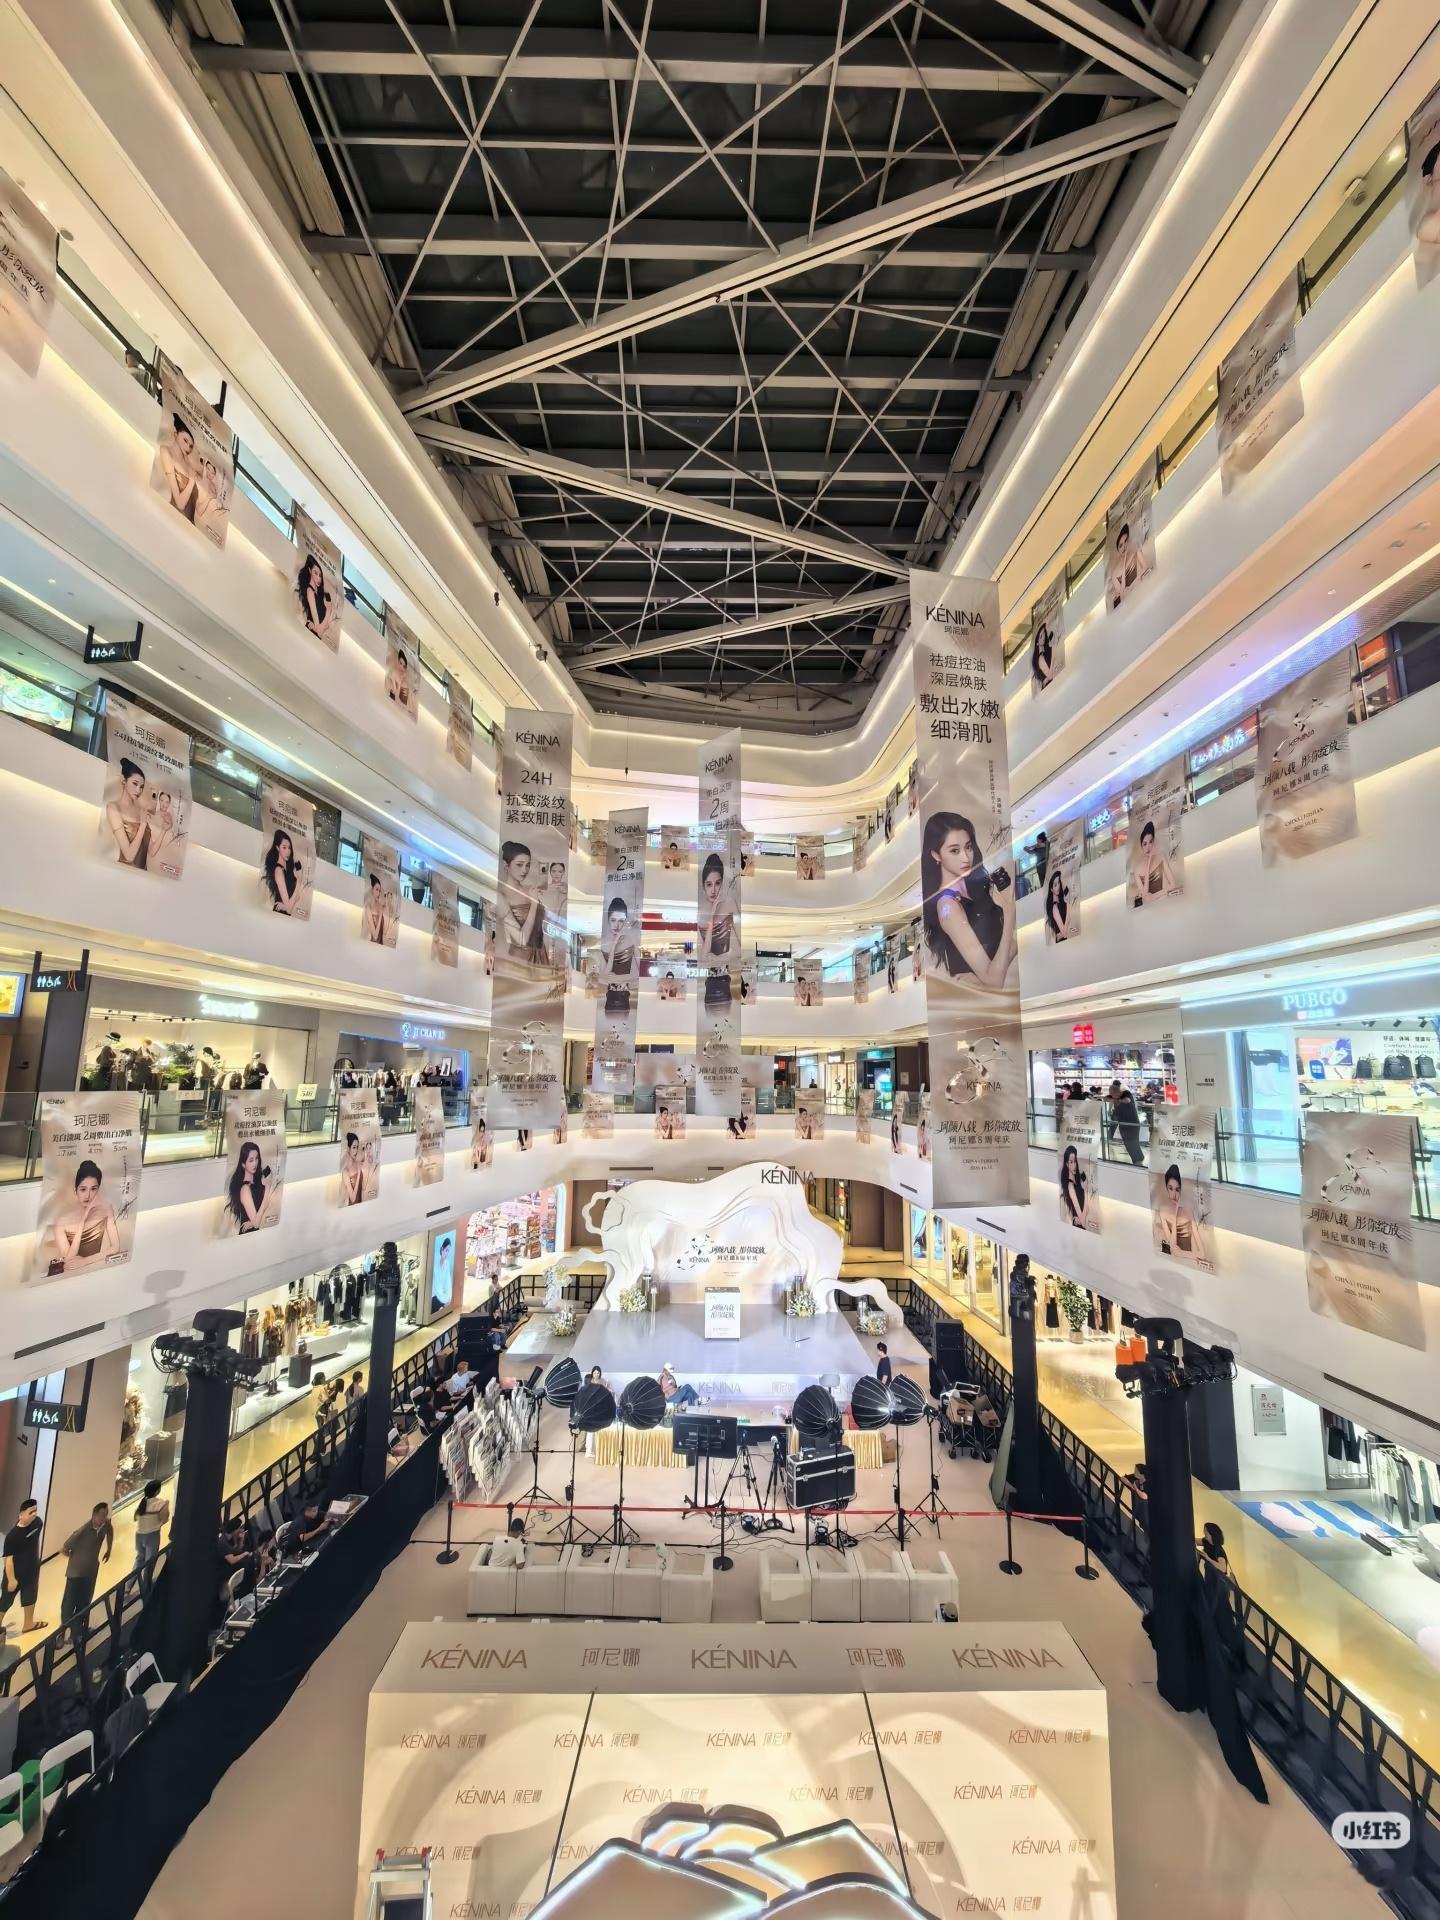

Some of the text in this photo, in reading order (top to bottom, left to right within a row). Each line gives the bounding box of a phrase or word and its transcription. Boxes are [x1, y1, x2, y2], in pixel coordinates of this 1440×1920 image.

[926, 604, 985, 628] KÉNINA
[929, 652, 986, 673] 祛痘控油
[930, 671, 988, 691] 深层焕肤
[920, 693, 1000, 720] 敷出水嫩
[516, 730, 560, 747] KÉNINA
[930, 718, 992, 744] 细滑肌
[705, 754, 733, 773] KÉNINA
[521, 770, 552, 785] 24H
[506, 792, 566, 810] 抗皱淡纹
[710, 798, 729, 819] 2周
[506, 809, 566, 827] 紧致肌肤
[617, 856, 634, 871] 2周
[1283, 988, 1347, 1010] PUBGO
[73, 1114, 111, 1127] 珂尼娜
[761, 1165, 816, 1186] KÉNINA
[1306, 1207, 1403, 1240] 珂颜八载 彤你绽放
[420, 1643, 527, 1670] KÉNINA
[580, 1647, 640, 1668] 珂尼娜
[690, 1643, 798, 1670] KÉNINA
[845, 1647, 906, 1669] 珂尼娜
[952, 1643, 1063, 1670] KÉNINA
[400, 1730, 451, 1749] KÉNINA
[554, 1730, 604, 1749] KÉNINA
[706, 1729, 756, 1748] KÉNINA
[858, 1726, 908, 1746] KÉNINA
[1008, 1725, 1057, 1745] KÉNINA
[455, 1786, 506, 1805] KÉNINA
[622, 1785, 673, 1804] KÉNINA
[788, 1783, 839, 1802] KÉNINA
[953, 1781, 1003, 1801] KÉNINA
[1012, 1836, 1061, 1855] KÉNINA
[450, 1899, 501, 1919] KÉNINA
[956, 1893, 1007, 1912] KÉNINA
